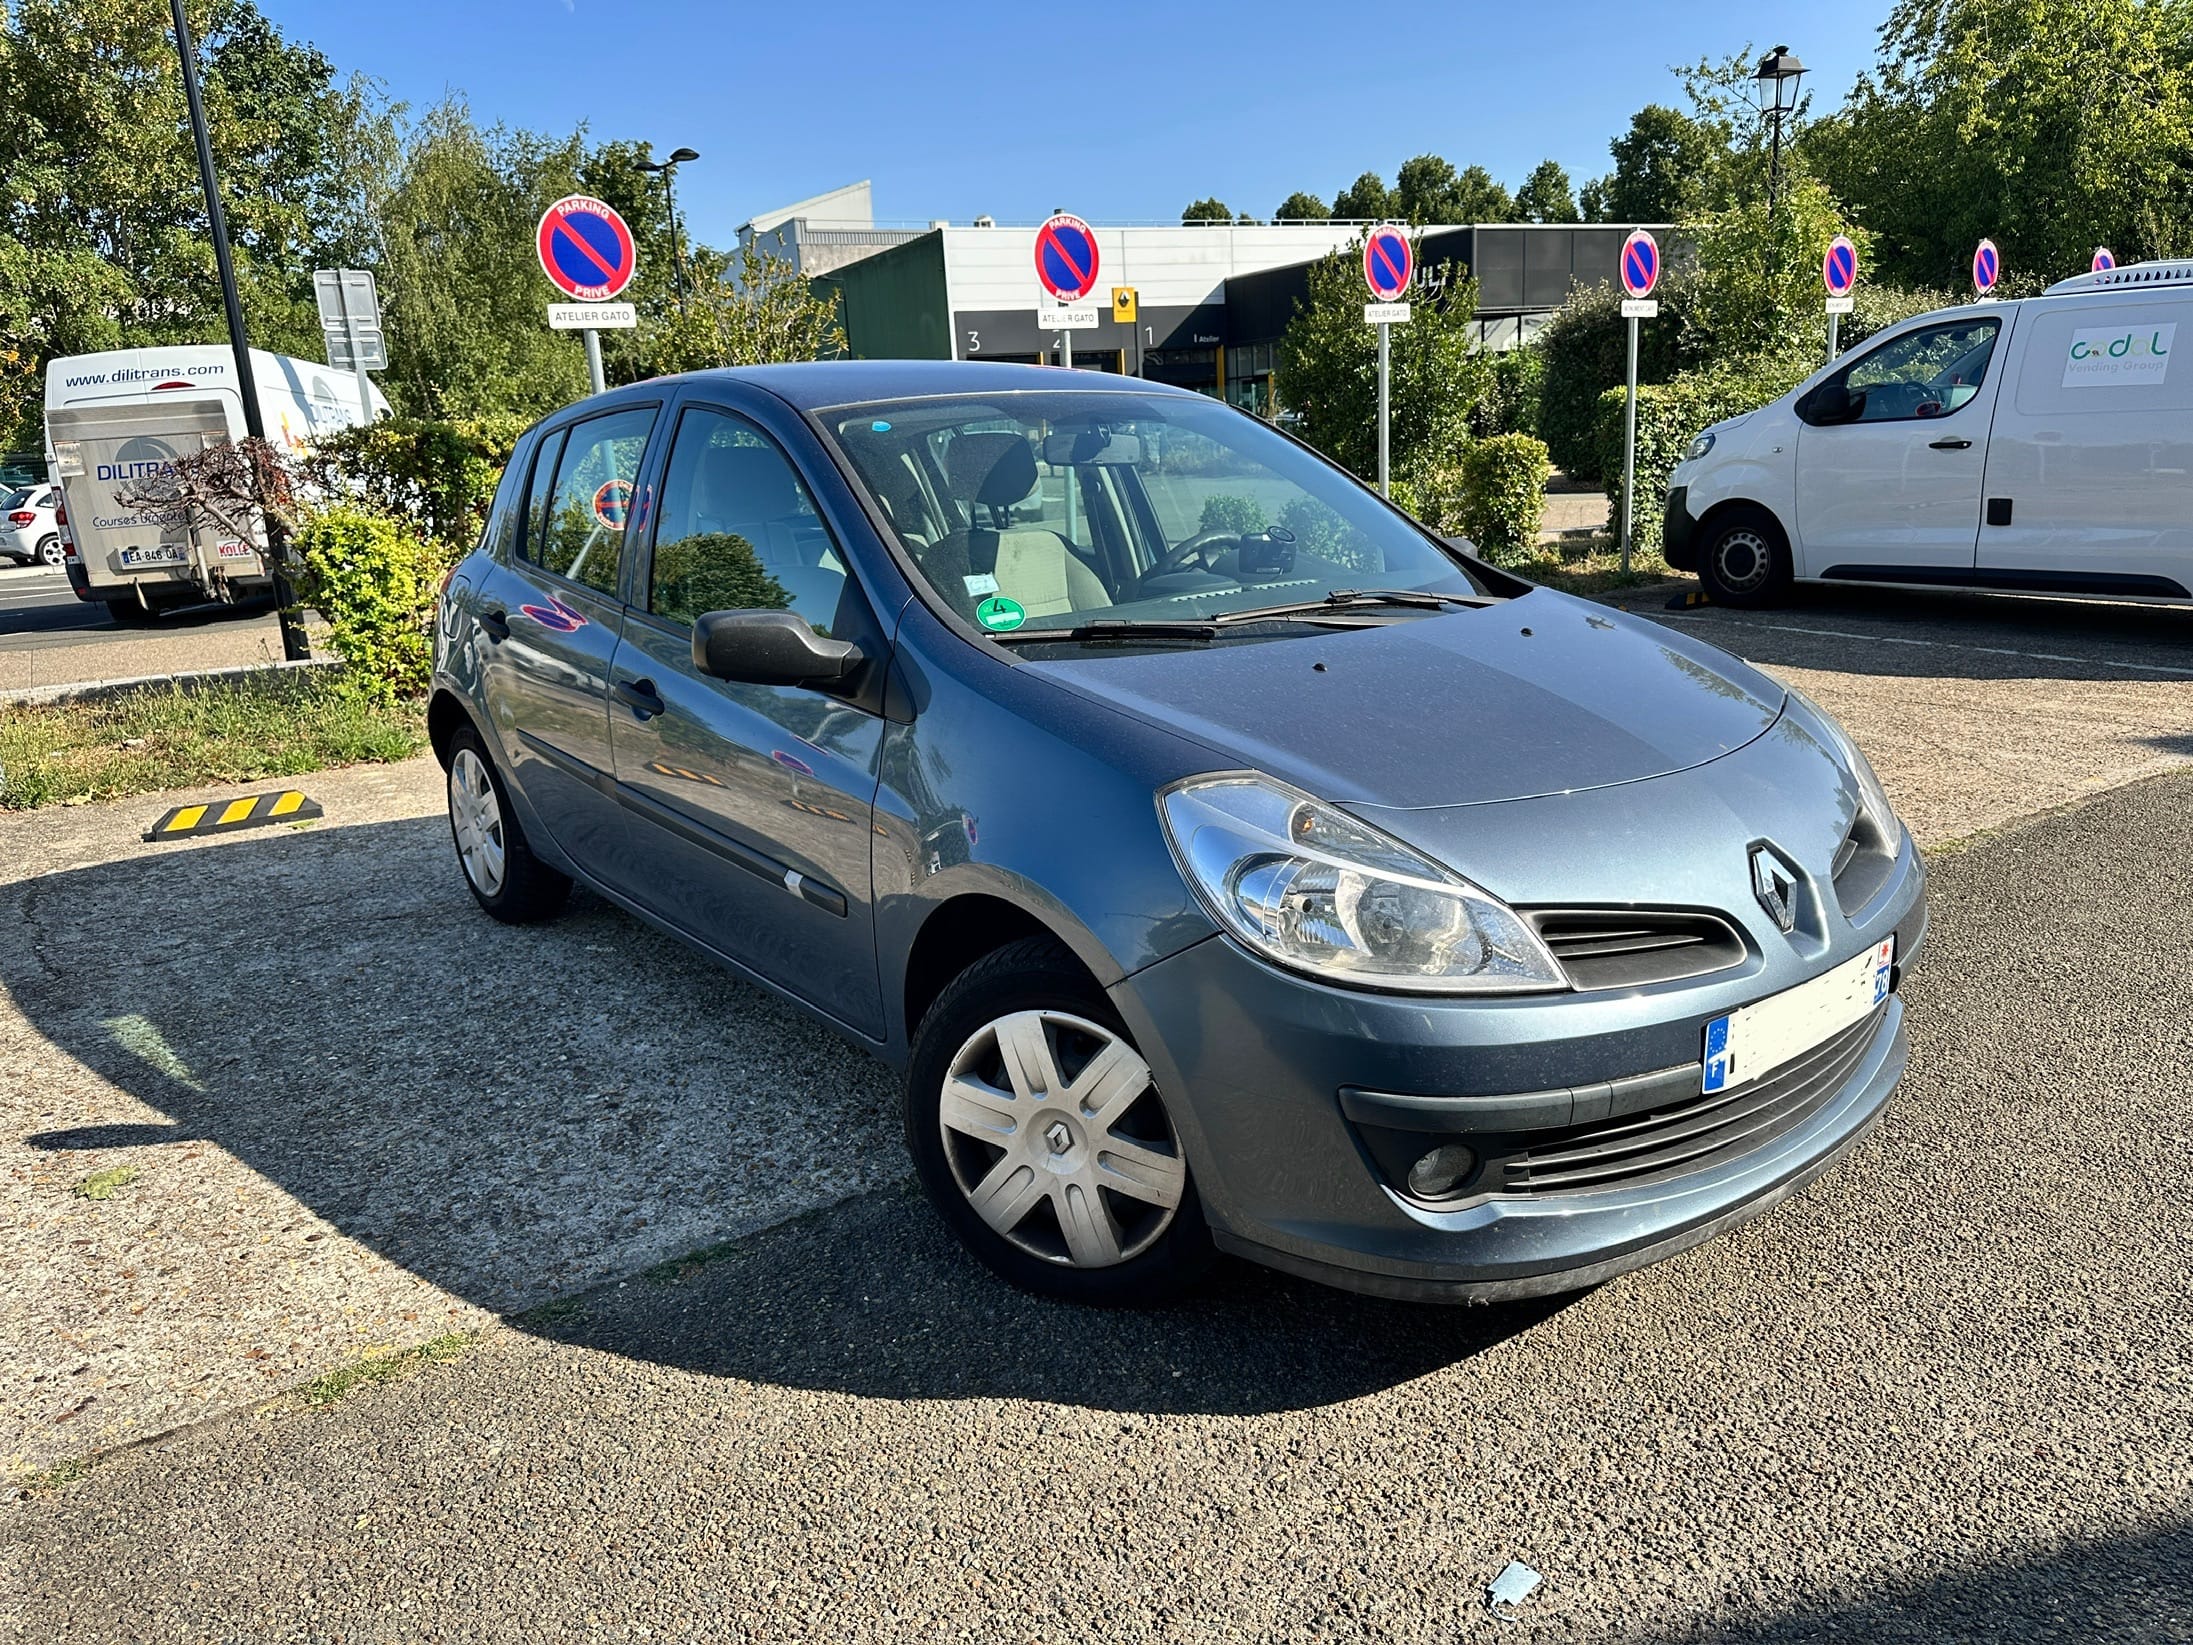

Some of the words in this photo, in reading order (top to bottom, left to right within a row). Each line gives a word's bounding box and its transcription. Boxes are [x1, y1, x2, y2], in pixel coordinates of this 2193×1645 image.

[556, 199, 610, 220] PARKING
[1048, 217, 1087, 234] PARKING
[574, 284, 611, 298] PRIVE
[555, 312, 599, 321] ATELIER
[601, 311, 630, 320] GATO
[1042, 314, 1073, 323] ATEER
[1074, 313, 1095, 322] GATO
[967, 331, 981, 352] 3
[1144, 326, 1153, 345] 1
[65, 364, 224, 387] www.dilitrans.com
[2068, 362, 2119, 374] Vending
[2123, 360, 2164, 372] Group
[92, 515, 137, 528] Courses
[993, 599, 1006, 613] 4
[1875, 970, 1888, 996] 78
[1710, 1061, 1720, 1078] F
